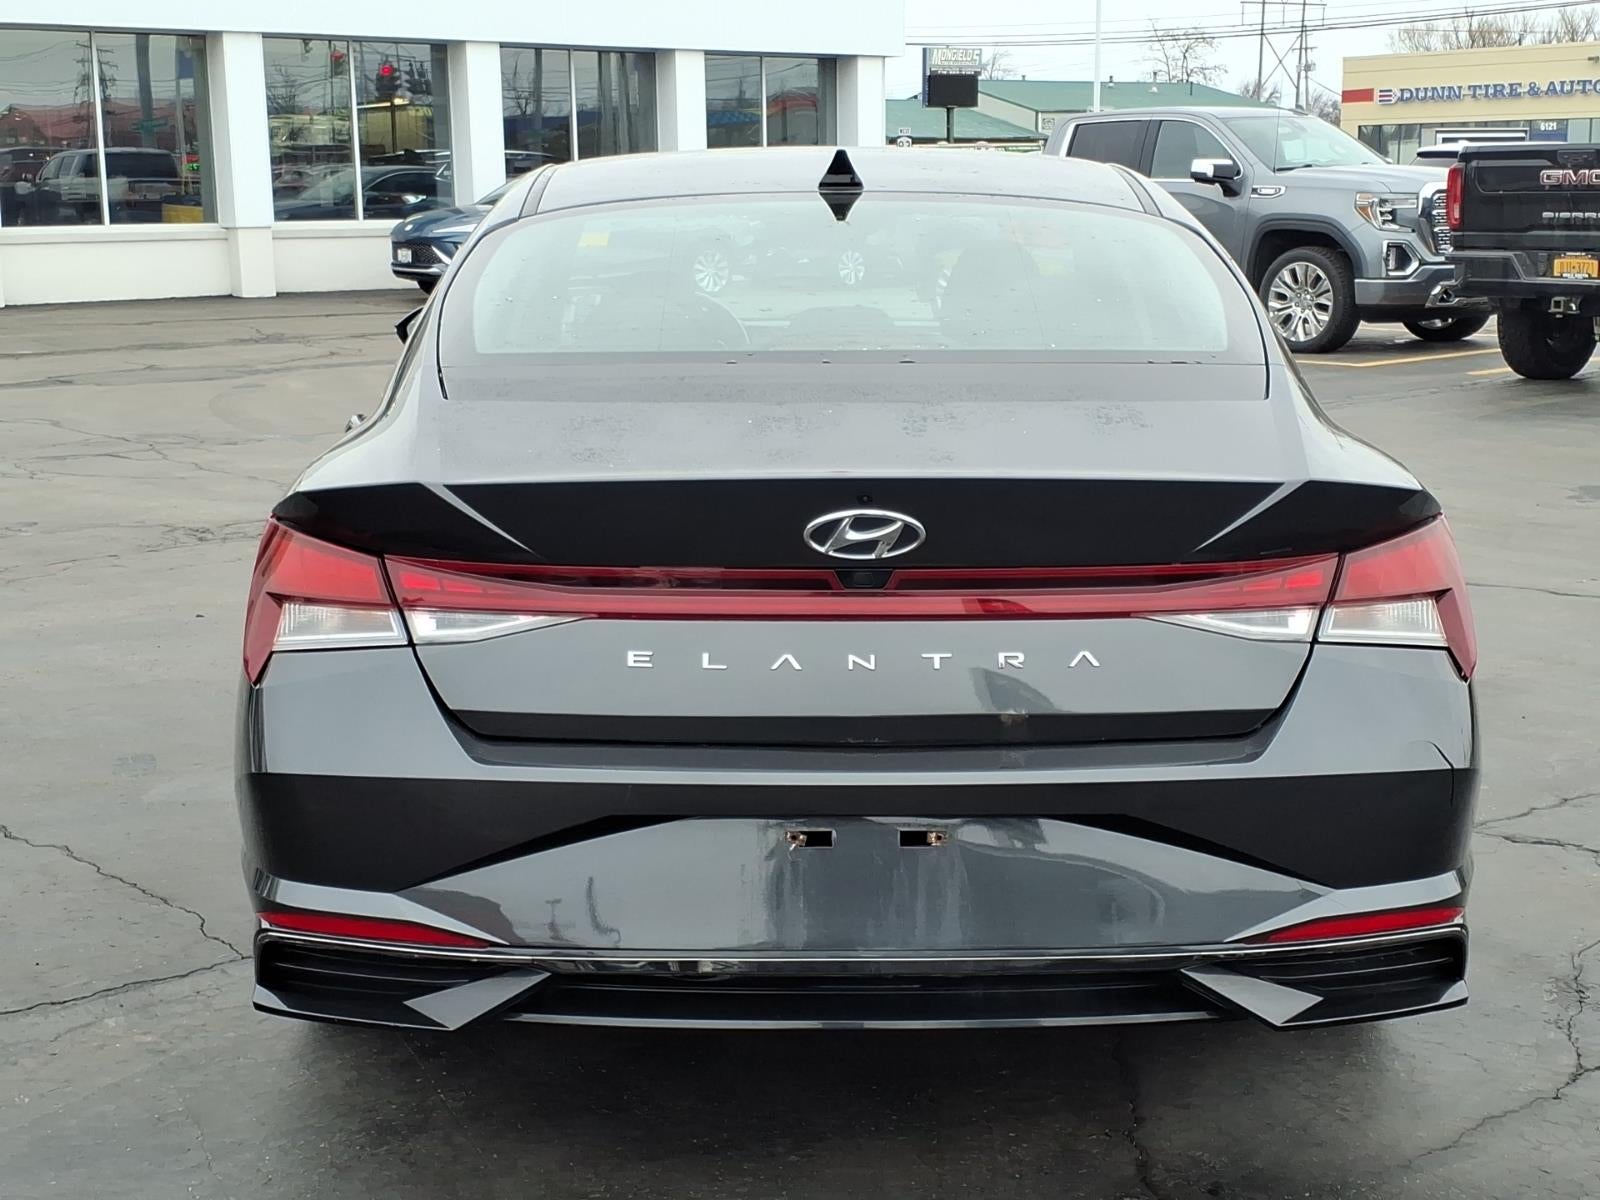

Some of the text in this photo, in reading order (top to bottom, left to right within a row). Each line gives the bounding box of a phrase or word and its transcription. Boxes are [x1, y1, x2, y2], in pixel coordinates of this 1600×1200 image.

[1399, 79, 1600, 103] DUNN TIRE & AUTO
[1540, 121, 1557, 131] 6121
[626, 650, 1100, 671] ELANTRA
